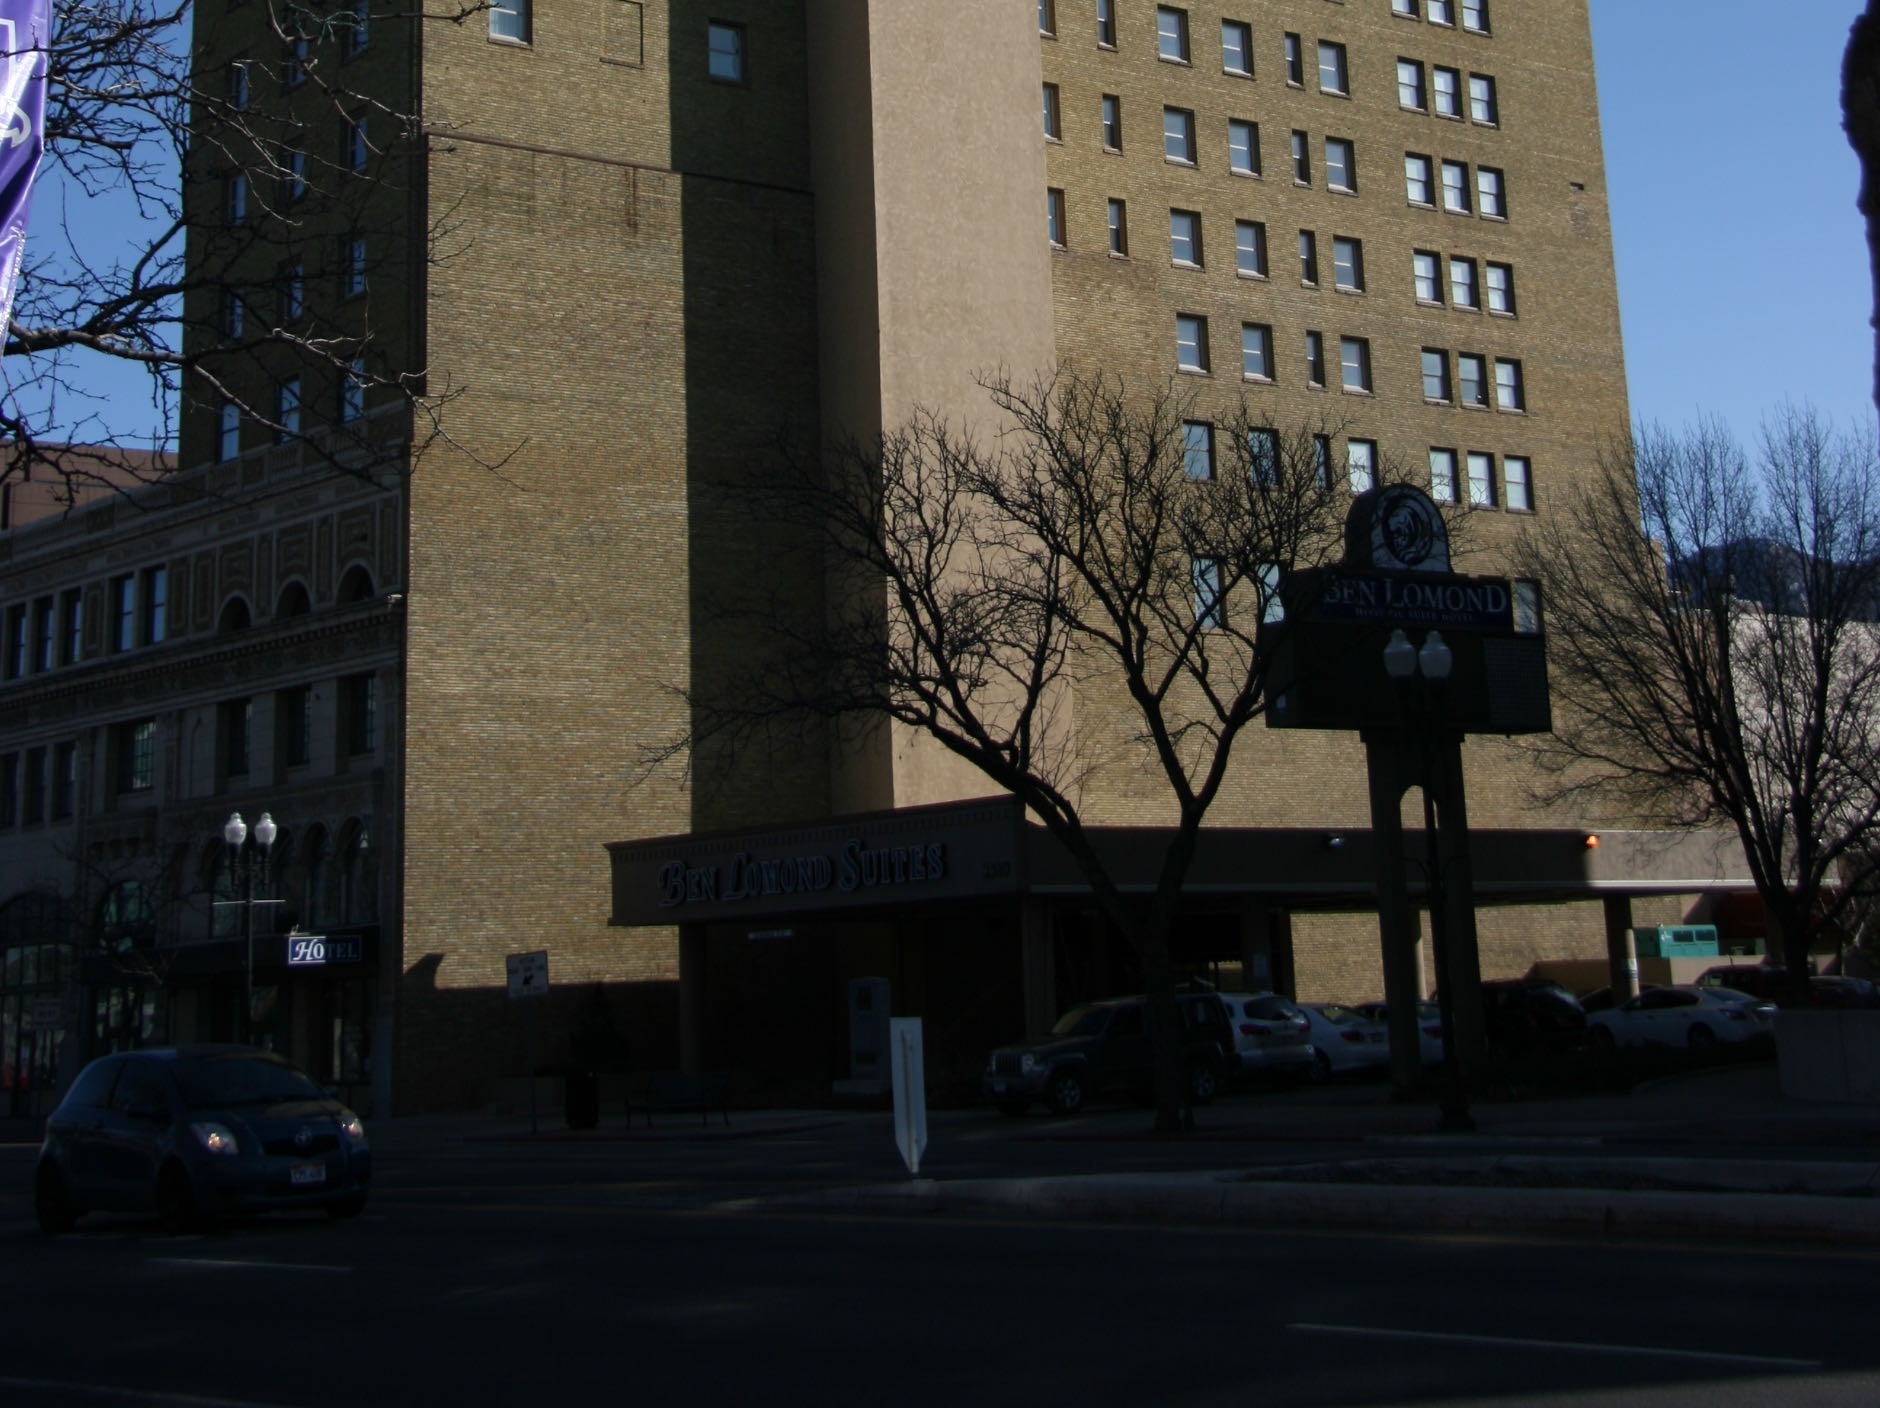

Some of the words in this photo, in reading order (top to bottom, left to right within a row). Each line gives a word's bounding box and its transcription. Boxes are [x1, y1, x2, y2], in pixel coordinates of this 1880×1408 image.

[1383, 578, 1507, 613] LOMOND
[657, 859, 720, 909] BEN
[722, 852, 834, 902] LOMOND
[838, 838, 948, 891] SUITES
[292, 938, 358, 961] HOTEL
